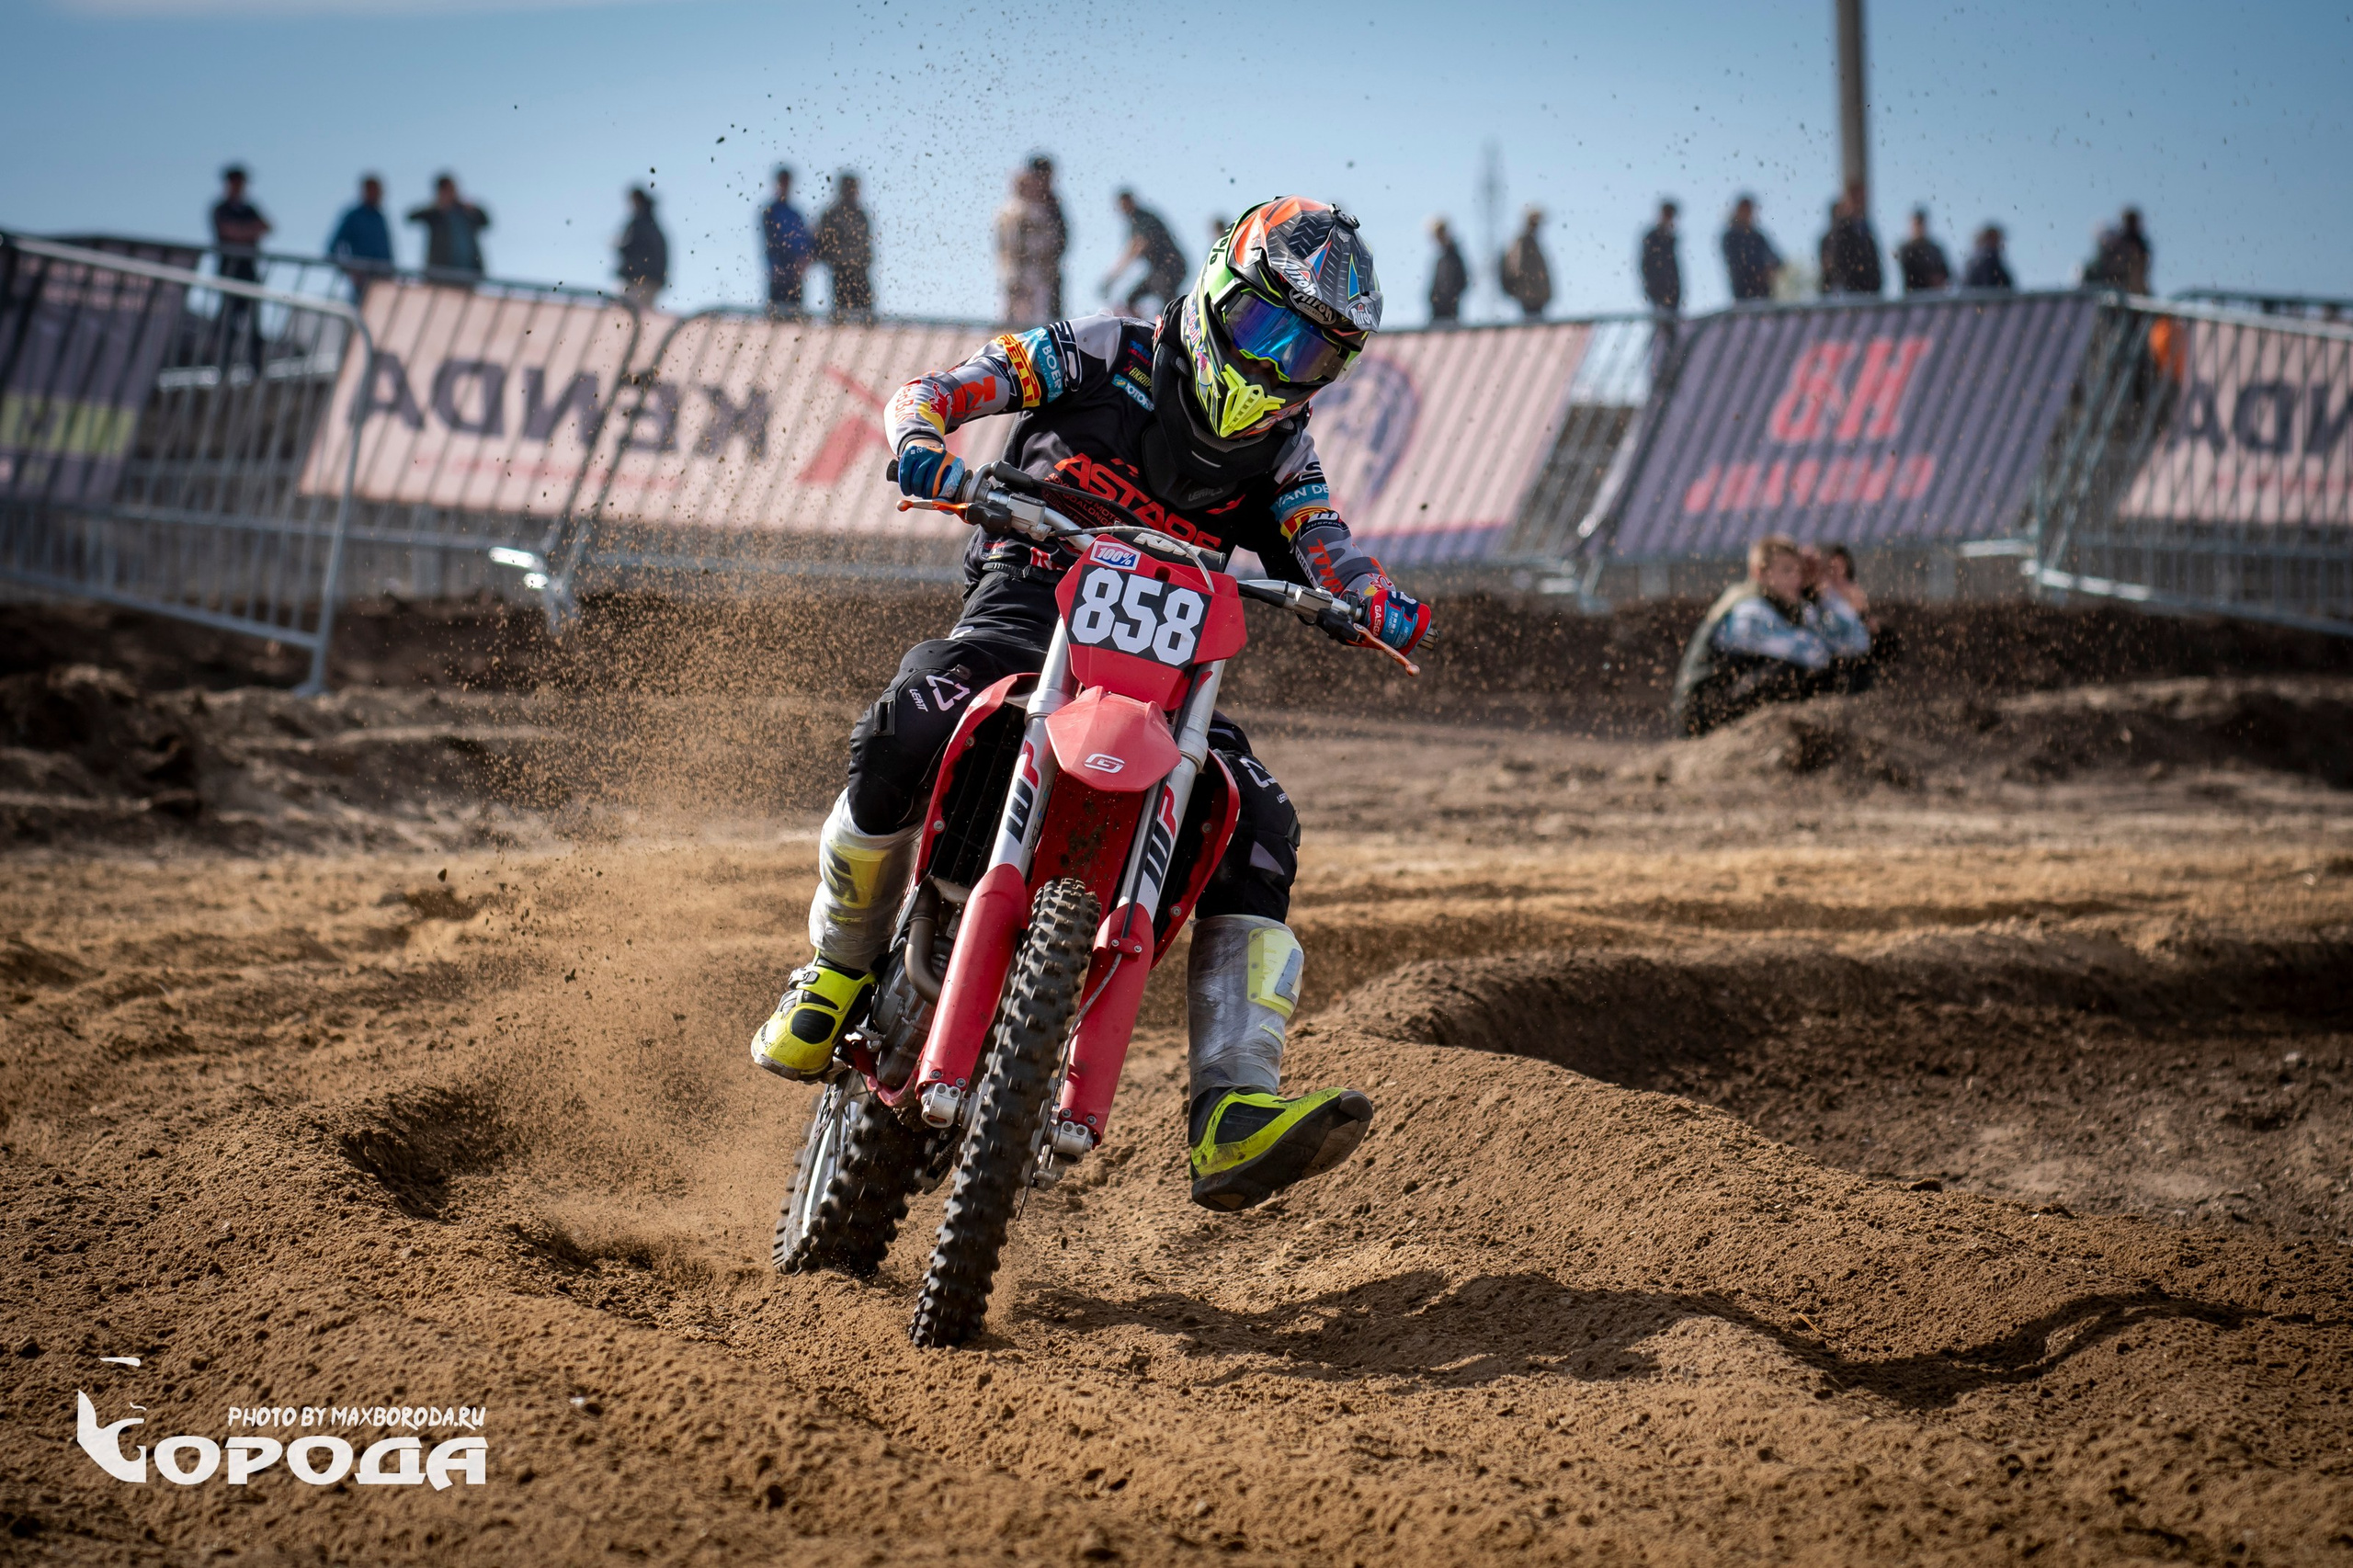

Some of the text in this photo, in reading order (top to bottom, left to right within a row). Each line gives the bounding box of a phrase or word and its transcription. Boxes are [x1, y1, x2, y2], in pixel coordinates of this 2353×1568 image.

[1292, 292, 1333, 322] Airoh
[1042, 345, 1062, 389] BOER
[1276, 487, 1307, 507] VAN
[1098, 547, 1132, 566] 100%
[1072, 567, 1205, 666] 858
[909, 688, 929, 712] LEATT
